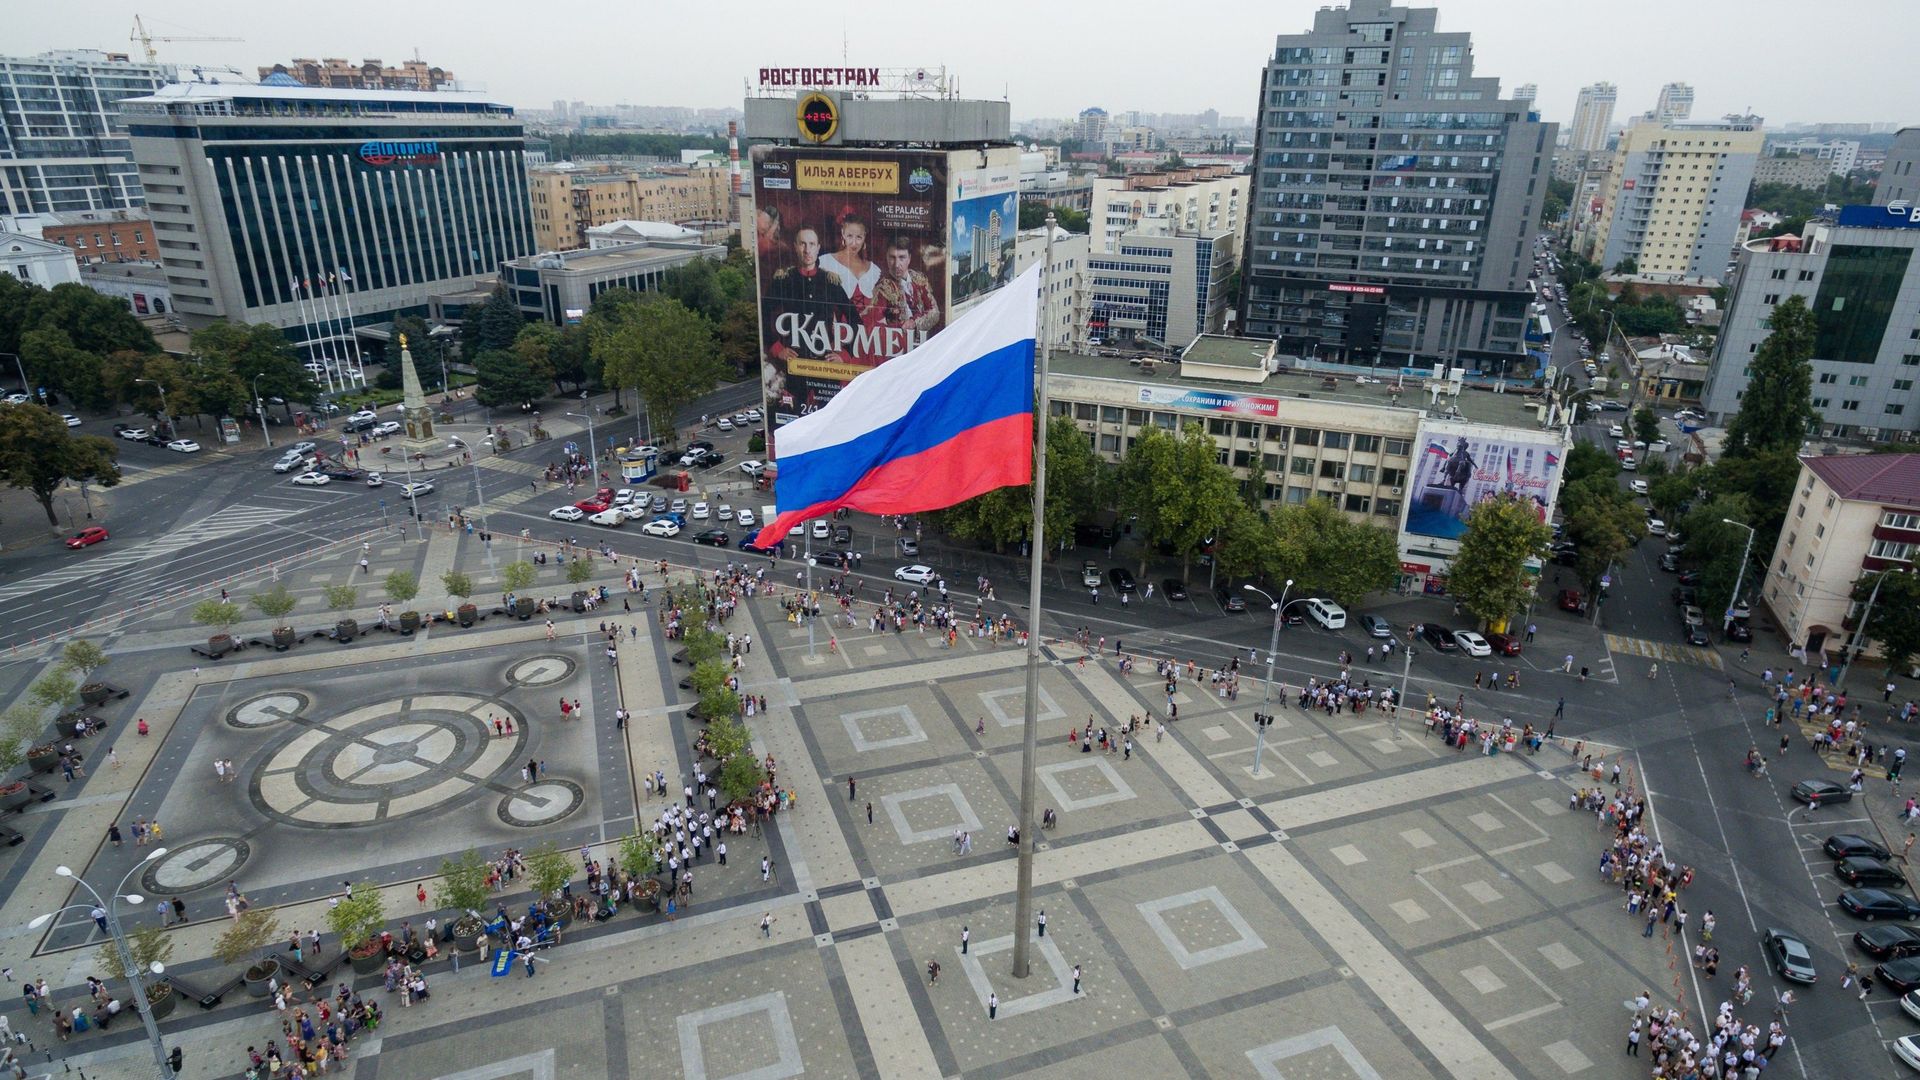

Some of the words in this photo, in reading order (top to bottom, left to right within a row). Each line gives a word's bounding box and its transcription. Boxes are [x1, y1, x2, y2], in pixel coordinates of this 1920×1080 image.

[759, 68, 879, 85] РОСГОССТРАХ
[804, 166, 834, 178] ИЛЬЯ
[838, 167, 892, 180] АВЕРБУХ
[895, 205, 929, 215] PALACE»
[797, 364, 822, 372] МИРОВАЯ
[823, 366, 850, 375] ПРЕМЬЕРА
[1223, 400, 1275, 412] ПРИУМНОЖИМ!
